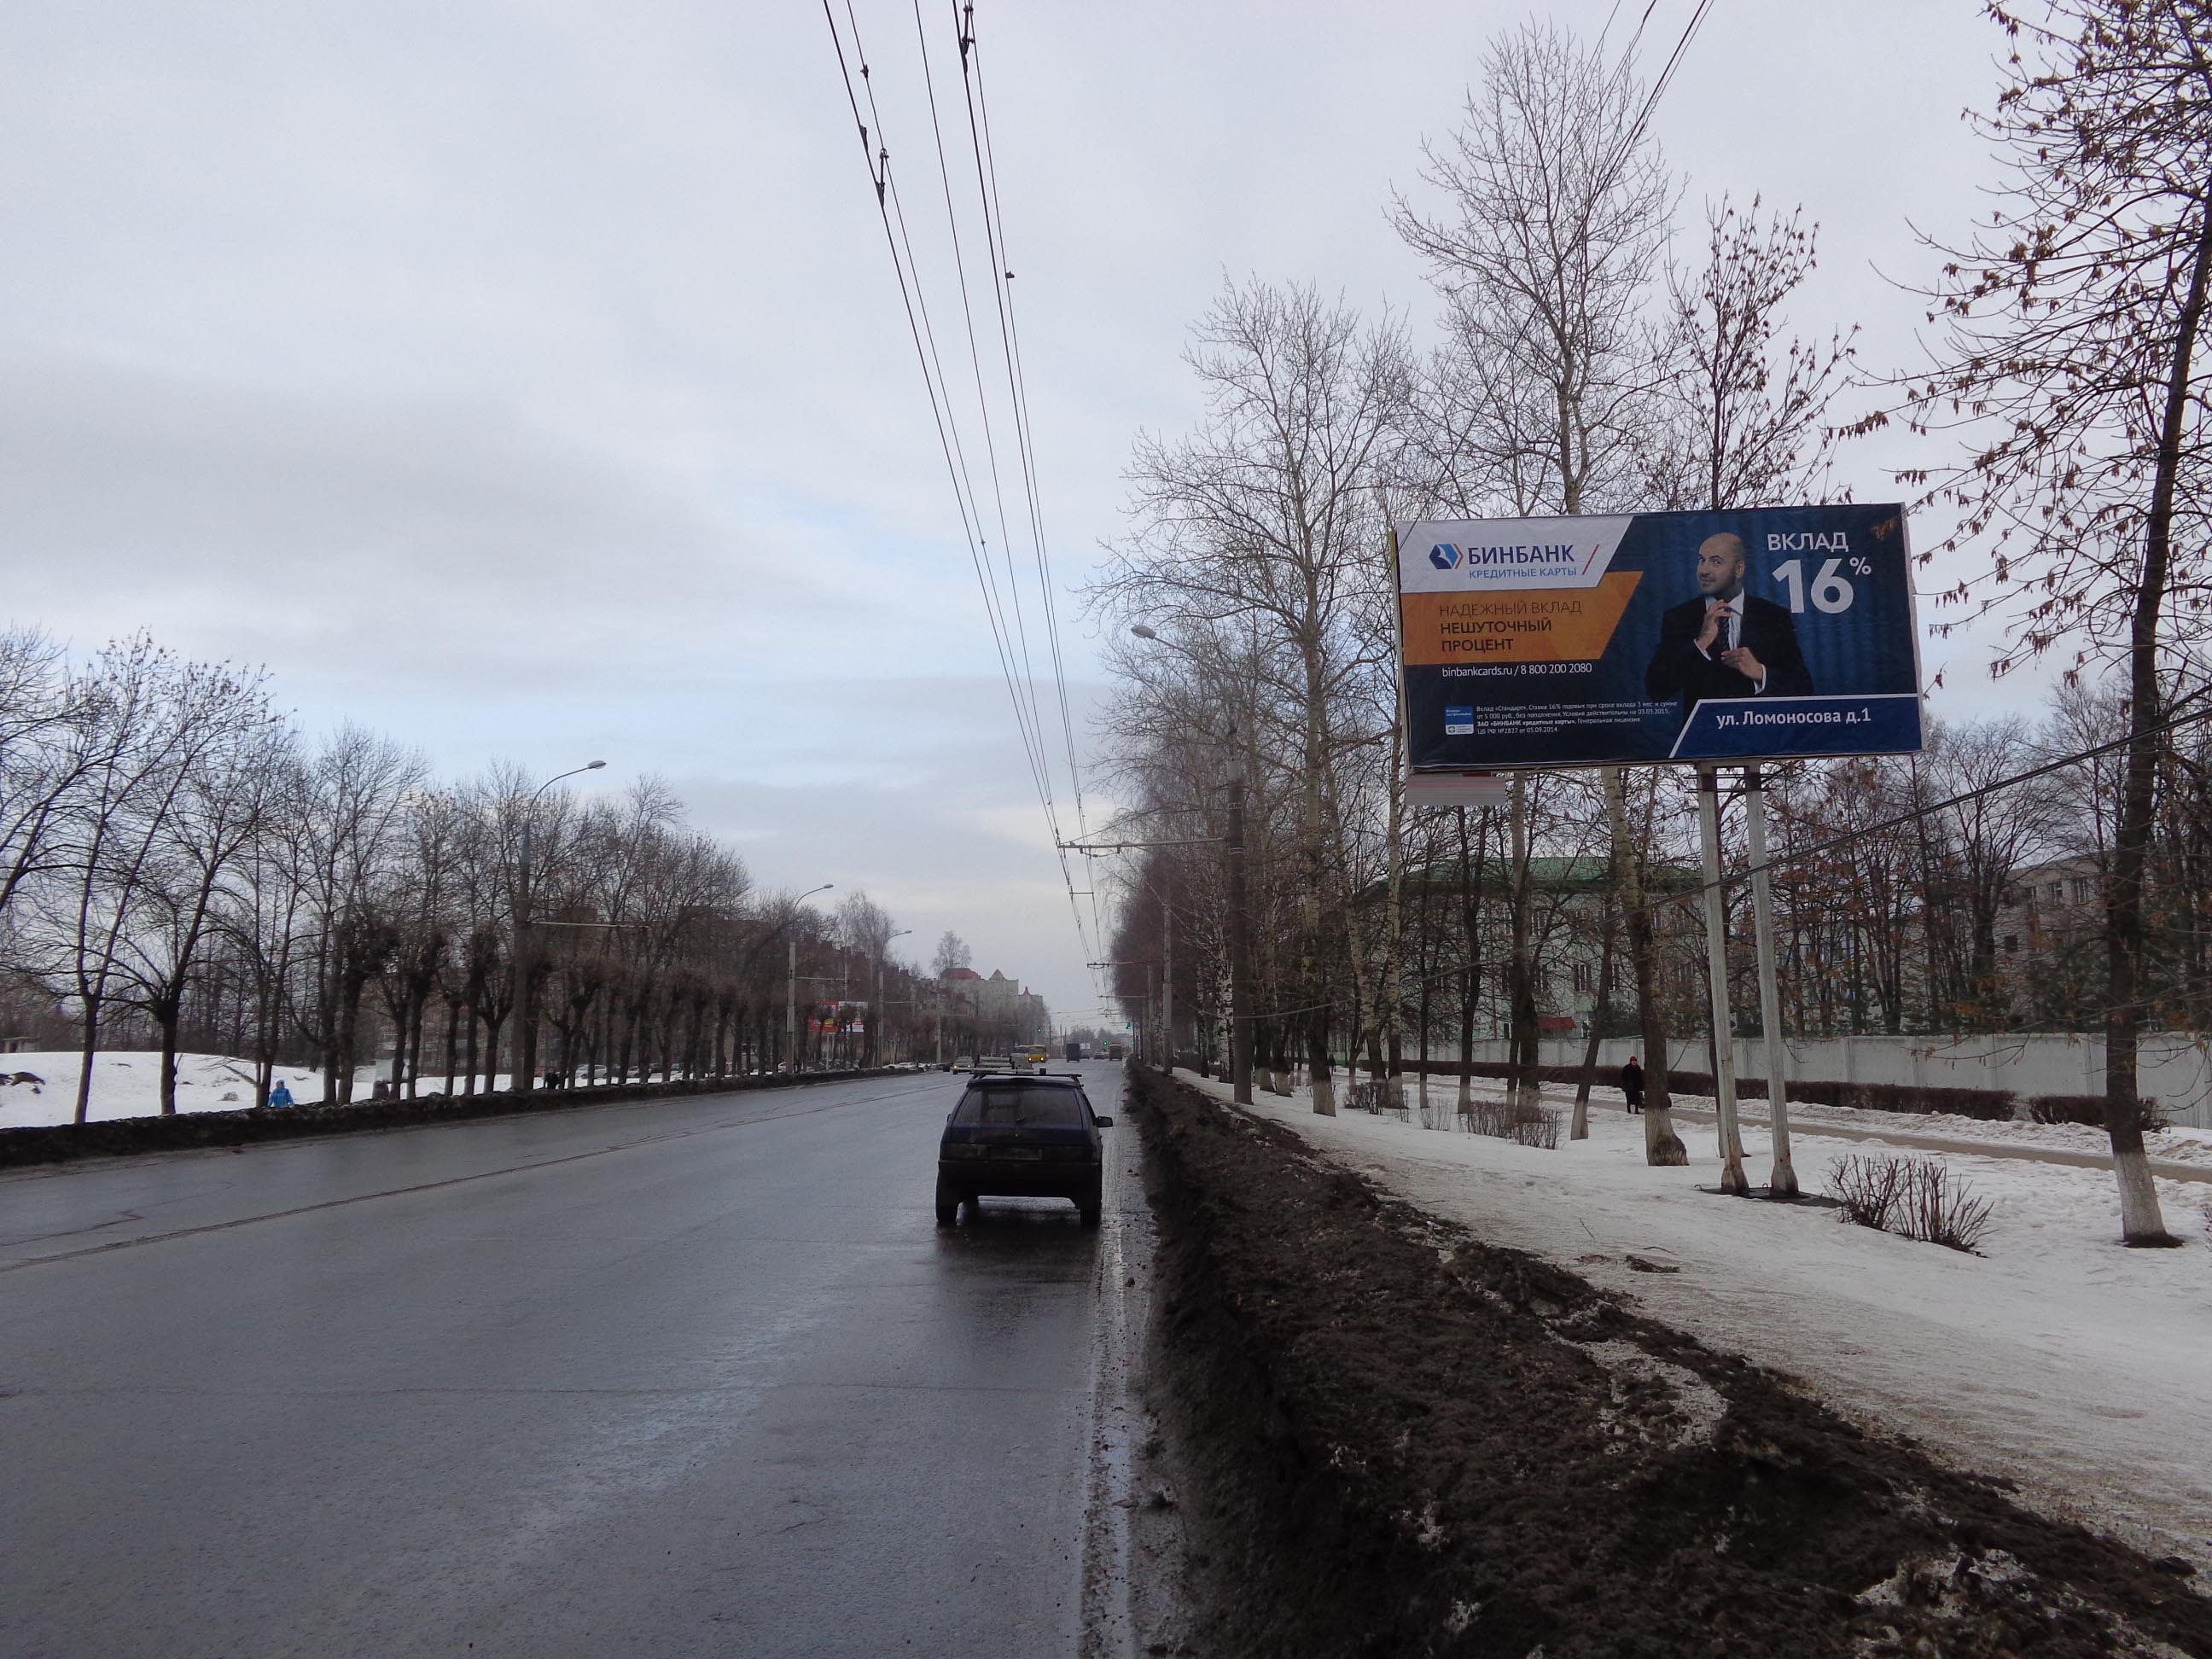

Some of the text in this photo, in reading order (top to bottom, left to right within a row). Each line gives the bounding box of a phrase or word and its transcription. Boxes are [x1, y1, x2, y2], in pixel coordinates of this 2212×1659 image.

[1767, 532, 1849, 552] ВКЛАД
[1468, 544, 1575, 565] БИНБАНК
[1469, 567, 1577, 579] КРЕДИТНЫЕ КАРТЫ
[1440, 601, 1582, 617] НАДЕЖНЫЙ ВКЛАД
[1441, 618, 1552, 635] НЕШУТОЧНЫЙ
[1441, 638, 1514, 654] ПРОЦЕНТ
[1441, 666, 1513, 678] binbankcards.ru
[1521, 666, 1528, 675] 8
[1528, 665, 1547, 675] 800
[1549, 664, 1567, 674] 200
[1569, 662, 1592, 673] 2080
[1716, 707, 1871, 730] ул. Ломоносова д.1
